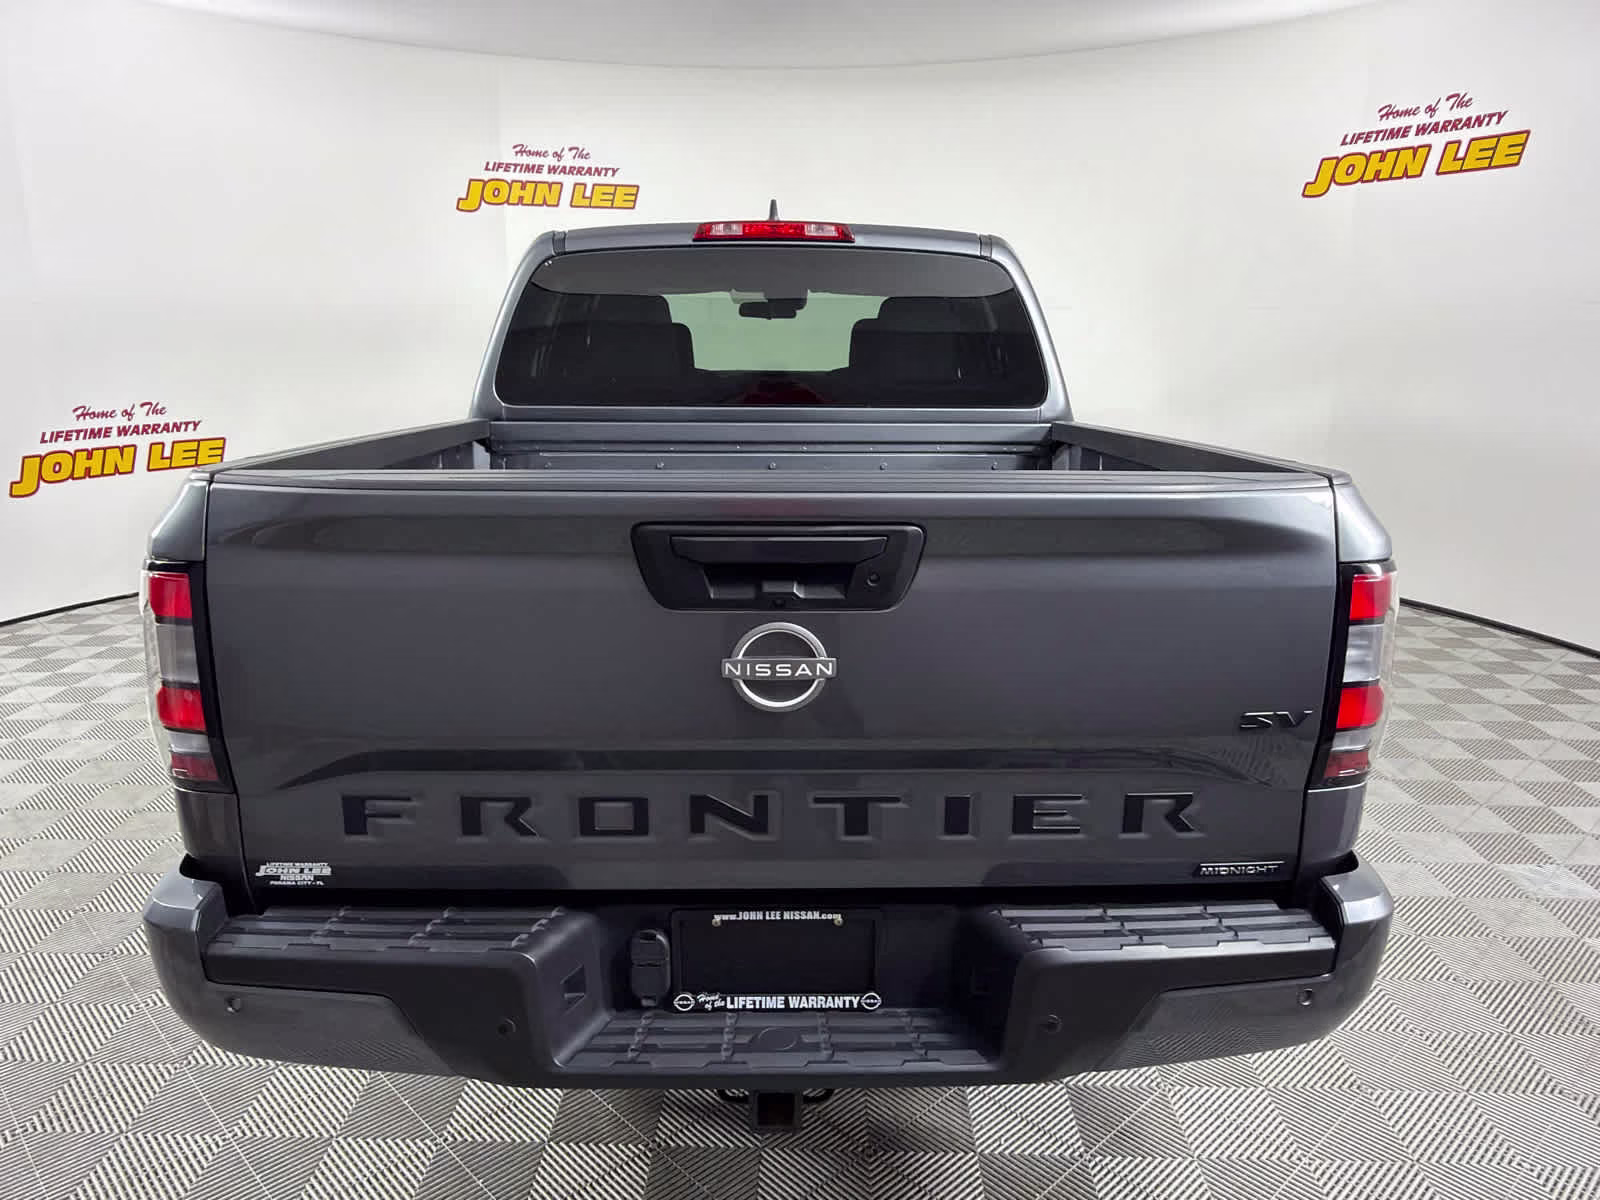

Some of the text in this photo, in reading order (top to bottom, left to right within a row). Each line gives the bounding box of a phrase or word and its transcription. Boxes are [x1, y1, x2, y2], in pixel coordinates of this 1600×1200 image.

[1377, 92, 1473, 121] Home of The
[1340, 110, 1509, 146] LIFETIME WARRANTY
[512, 144, 591, 163] Home of The
[1302, 129, 1531, 198] JOHN LEE
[484, 161, 620, 177] LIFETIME WARRANTY
[456, 178, 640, 212] JOHN LEE
[72, 401, 167, 422] Home of The
[40, 420, 202, 444] LIFETIME WARRANTY
[9, 437, 226, 498] JOHN LEE
[724, 662, 833, 677] NISSAN
[1240, 711, 1314, 729] SV
[340, 792, 1203, 838] FRONTIER
[256, 865, 301, 876] JOHN
[1199, 864, 1280, 876] MIDNIGHT
[766, 911, 781, 920] LEE
[726, 995, 785, 1009] LIFETIME
[788, 995, 860, 1009] WARRANTY
